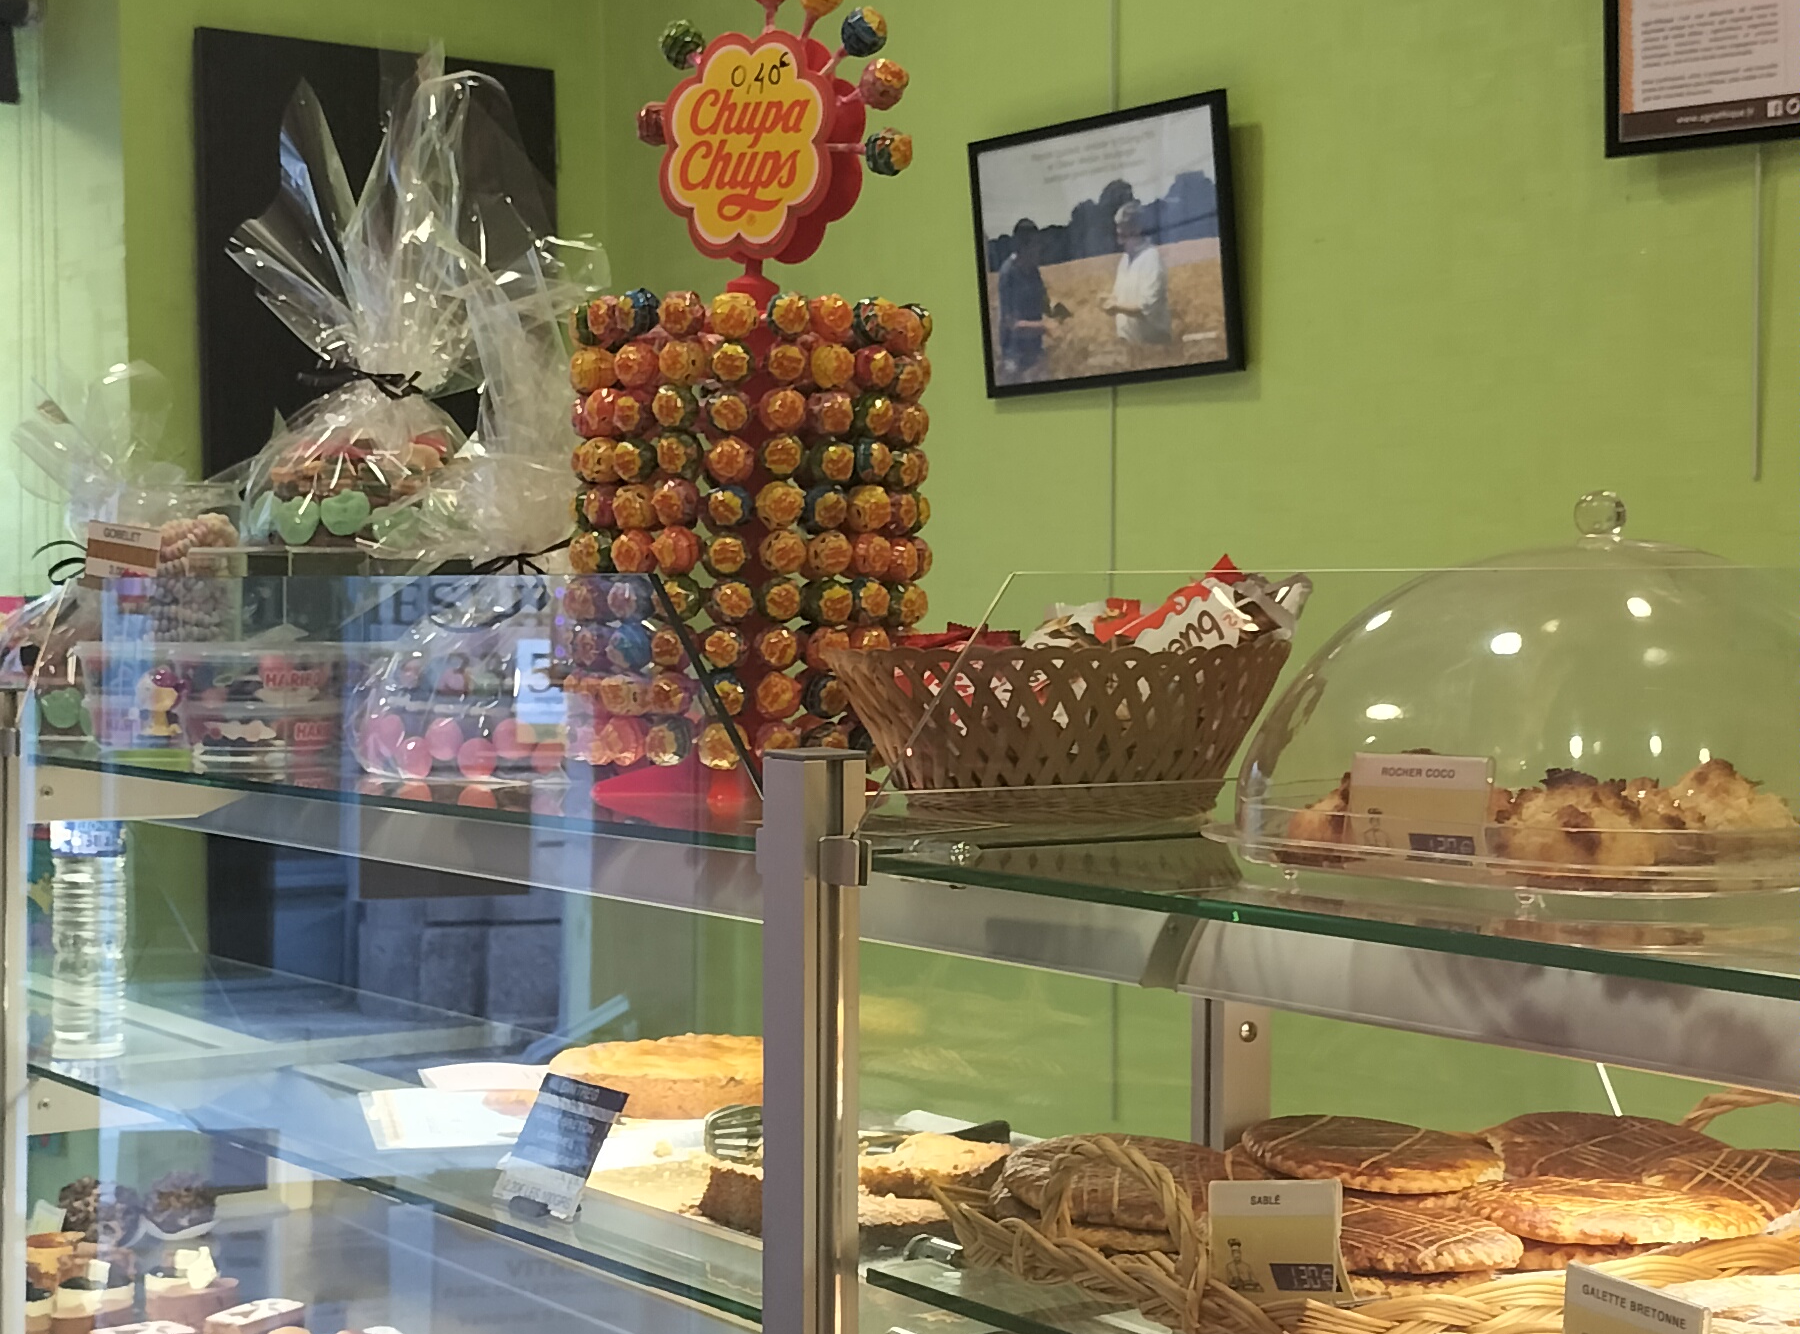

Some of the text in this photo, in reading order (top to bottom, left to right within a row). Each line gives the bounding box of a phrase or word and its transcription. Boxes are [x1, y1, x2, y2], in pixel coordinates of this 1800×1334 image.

[689, 88, 811, 148] Chupa
[679, 140, 801, 222] Chups
[1381, 766, 1456, 780] ROCHER COCO
[1250, 1194, 1281, 1206] SABLÉ
[1582, 1283, 1687, 1330] GALETTE BRETONNE
